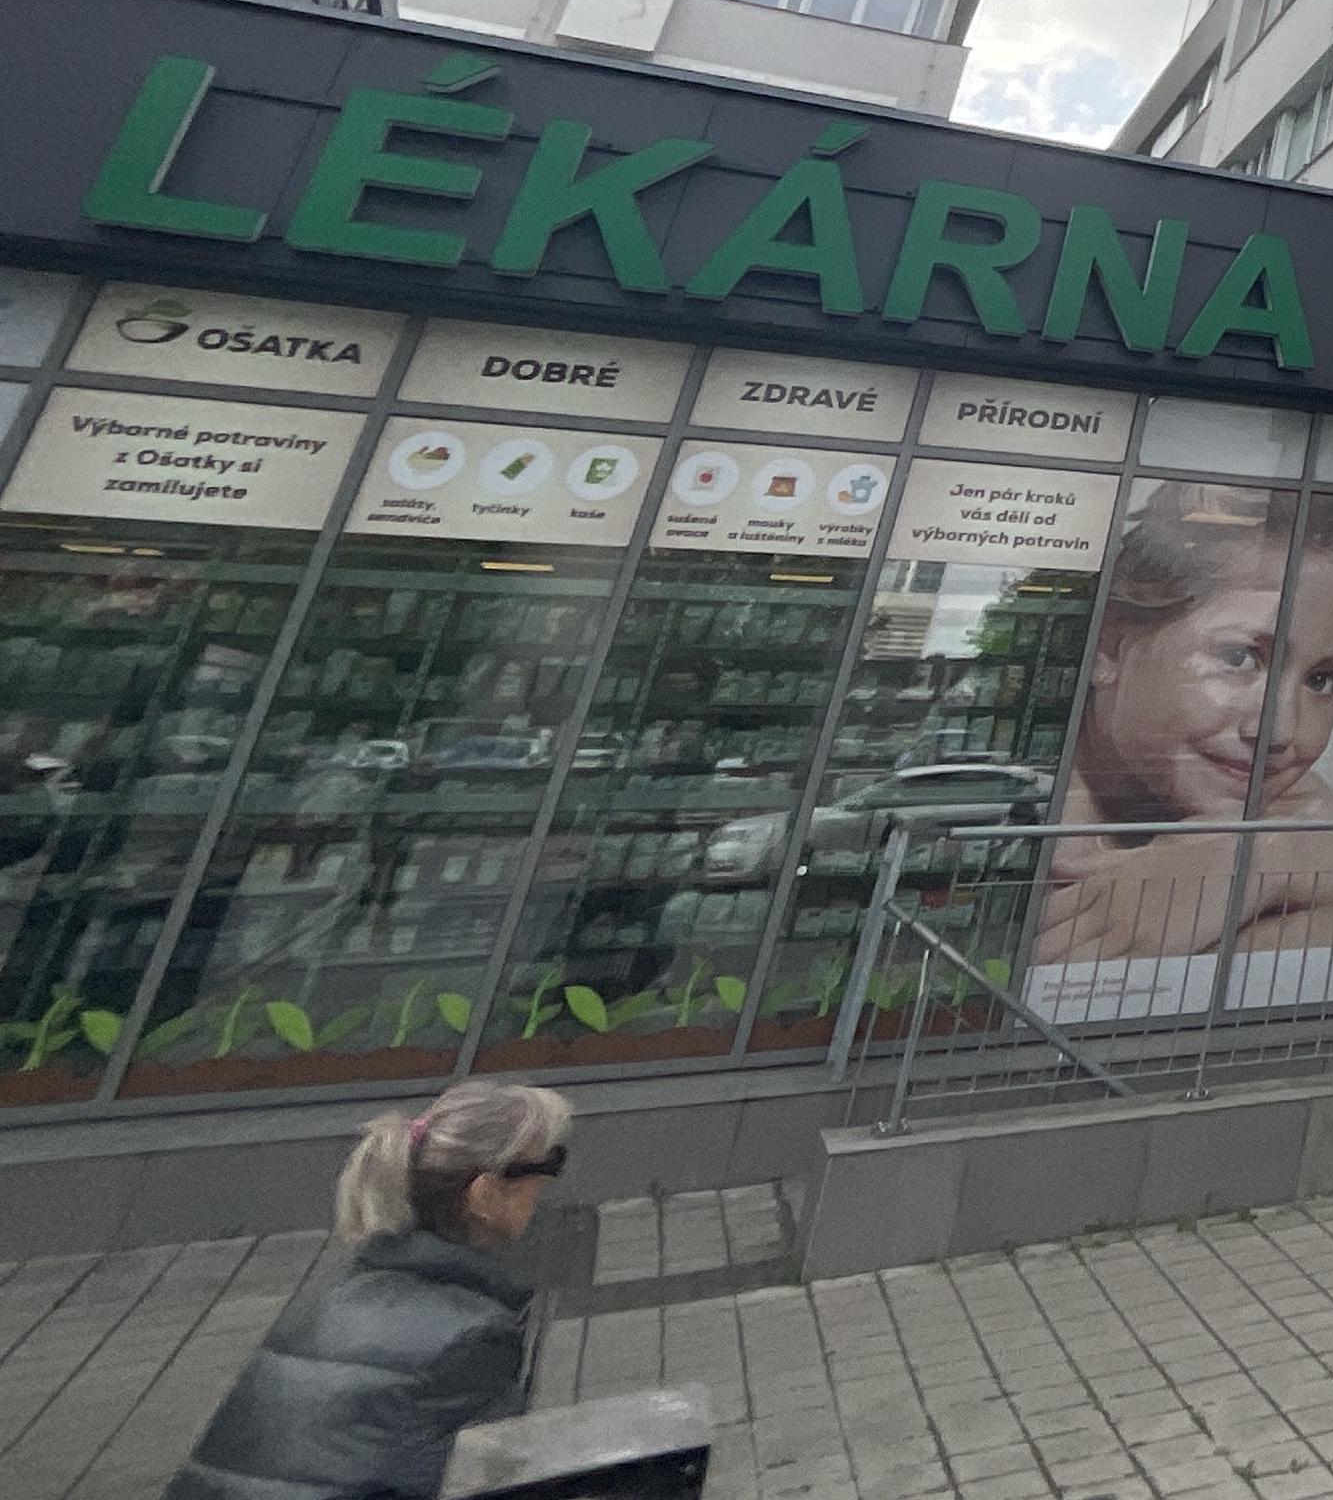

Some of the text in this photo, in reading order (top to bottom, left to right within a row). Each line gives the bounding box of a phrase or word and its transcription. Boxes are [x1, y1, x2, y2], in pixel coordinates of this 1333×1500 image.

[82, 52, 1314, 371] LÉKÁRNA
[197, 324, 362, 364] OŠATKA
[481, 356, 620, 388] DOBRÉ
[740, 381, 878, 412] ZDRAVÉ
[957, 399, 1104, 434] PŘÍRODNÍ
[72, 416, 327, 454] Výborné potraviny
[136, 450, 236, 474] Ošatky
[103, 478, 248, 500] zamilujete
[949, 484, 1076, 505] Jen pár kroků
[960, 508, 1057, 526] vás dělí od
[912, 527, 1089, 550] výborných potravin
